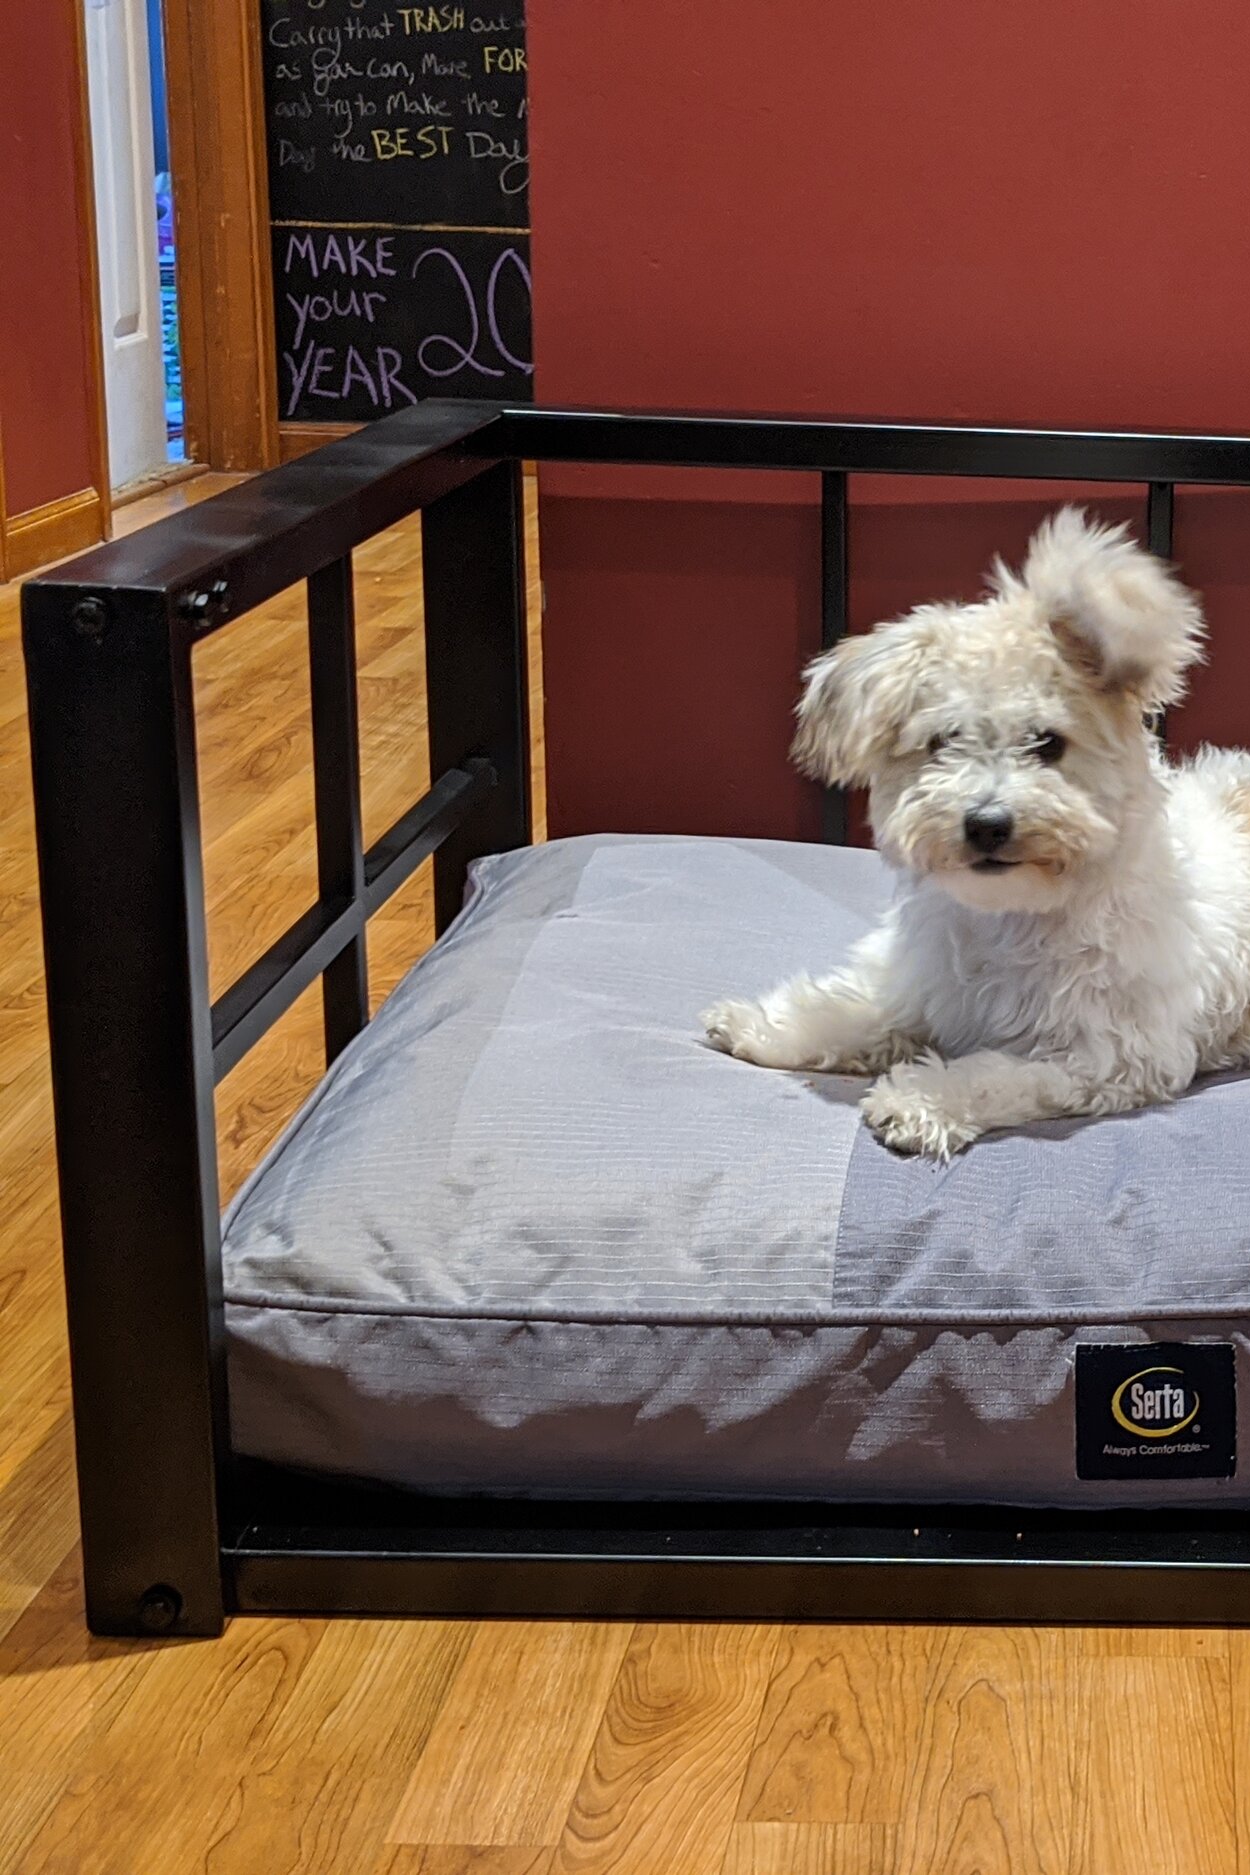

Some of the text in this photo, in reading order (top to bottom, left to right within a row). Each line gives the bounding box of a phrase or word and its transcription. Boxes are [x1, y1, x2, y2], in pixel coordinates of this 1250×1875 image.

[269, 5, 511, 71] Carry that TRASH out
[275, 63, 301, 80] as
[319, 95, 353, 138] try
[354, 93, 377, 117] to
[462, 92, 506, 118] the
[371, 125, 455, 160] BEST
[284, 233, 397, 278] MAKE
[286, 289, 387, 350] your
[283, 340, 418, 416] YEAR
[1131, 1383, 1184, 1420] Serta
[1103, 1444, 1137, 1457] Always
